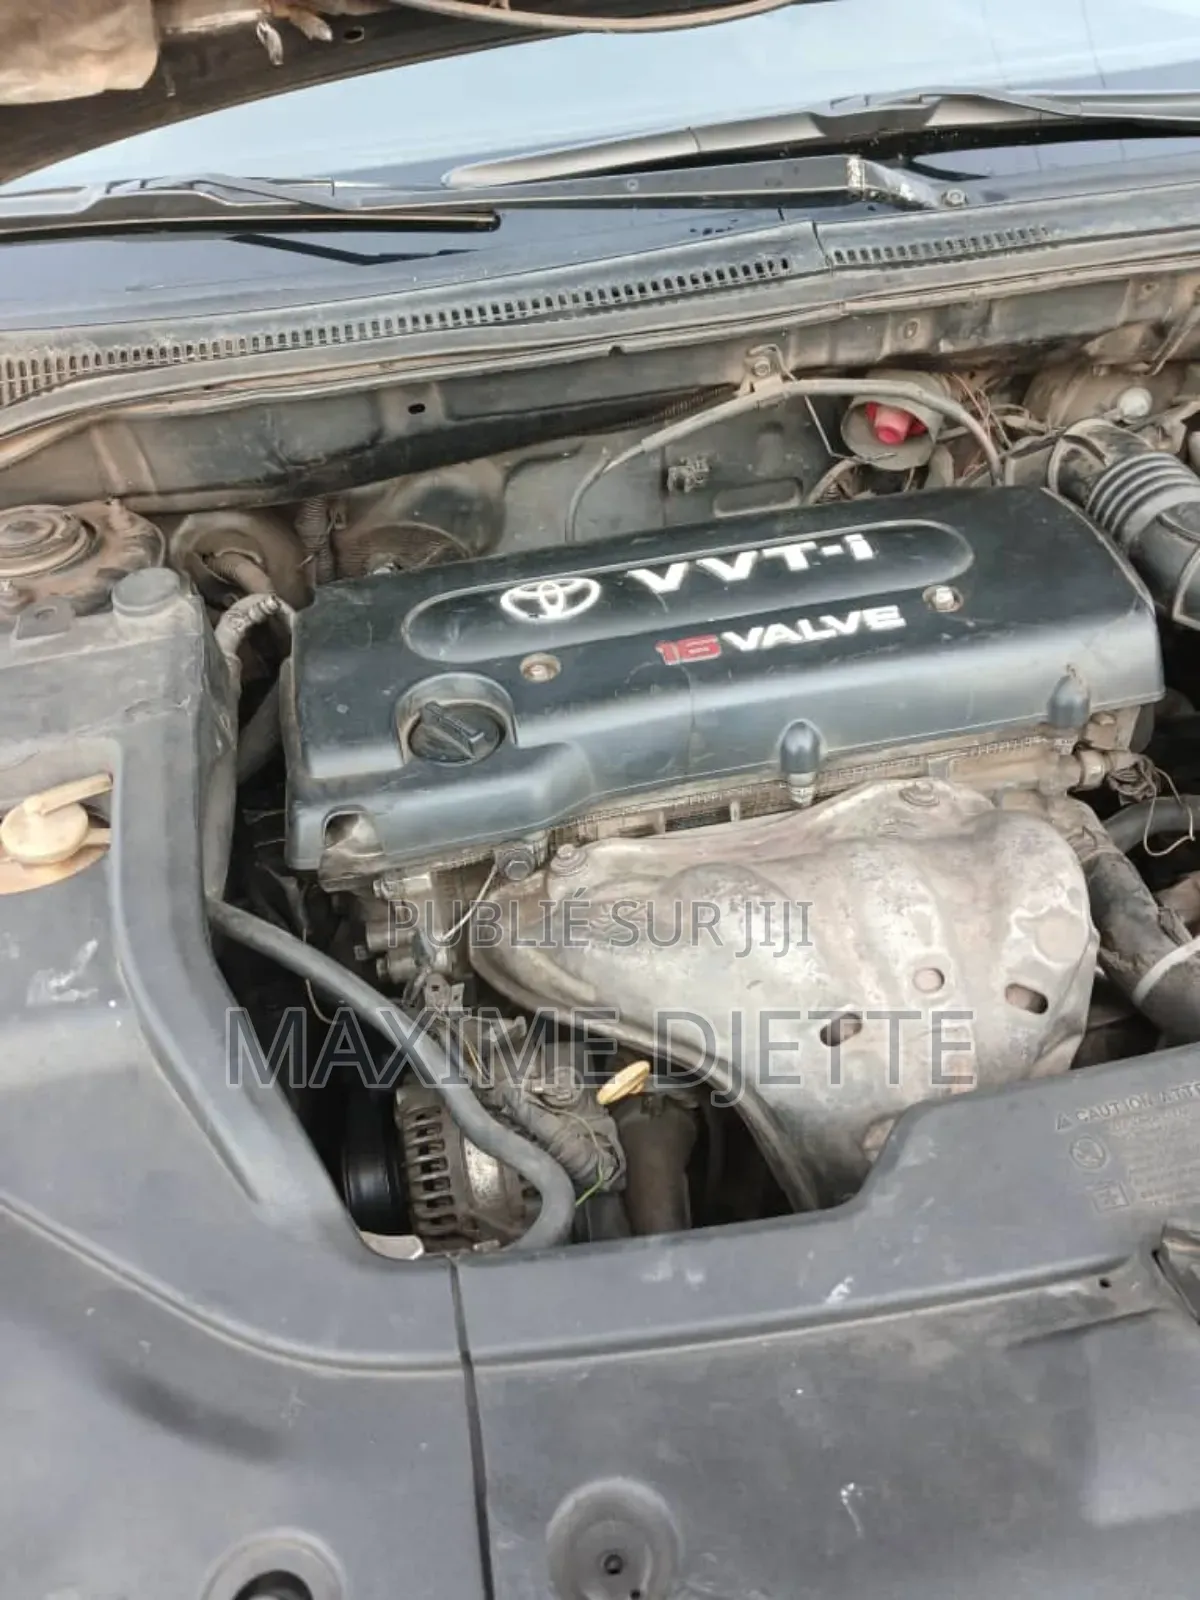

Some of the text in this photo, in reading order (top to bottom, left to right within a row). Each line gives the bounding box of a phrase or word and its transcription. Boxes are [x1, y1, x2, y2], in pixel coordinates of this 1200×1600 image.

[656, 605, 906, 665] 16 VALVE
[1075, 1092, 1154, 1122] CAUTION
